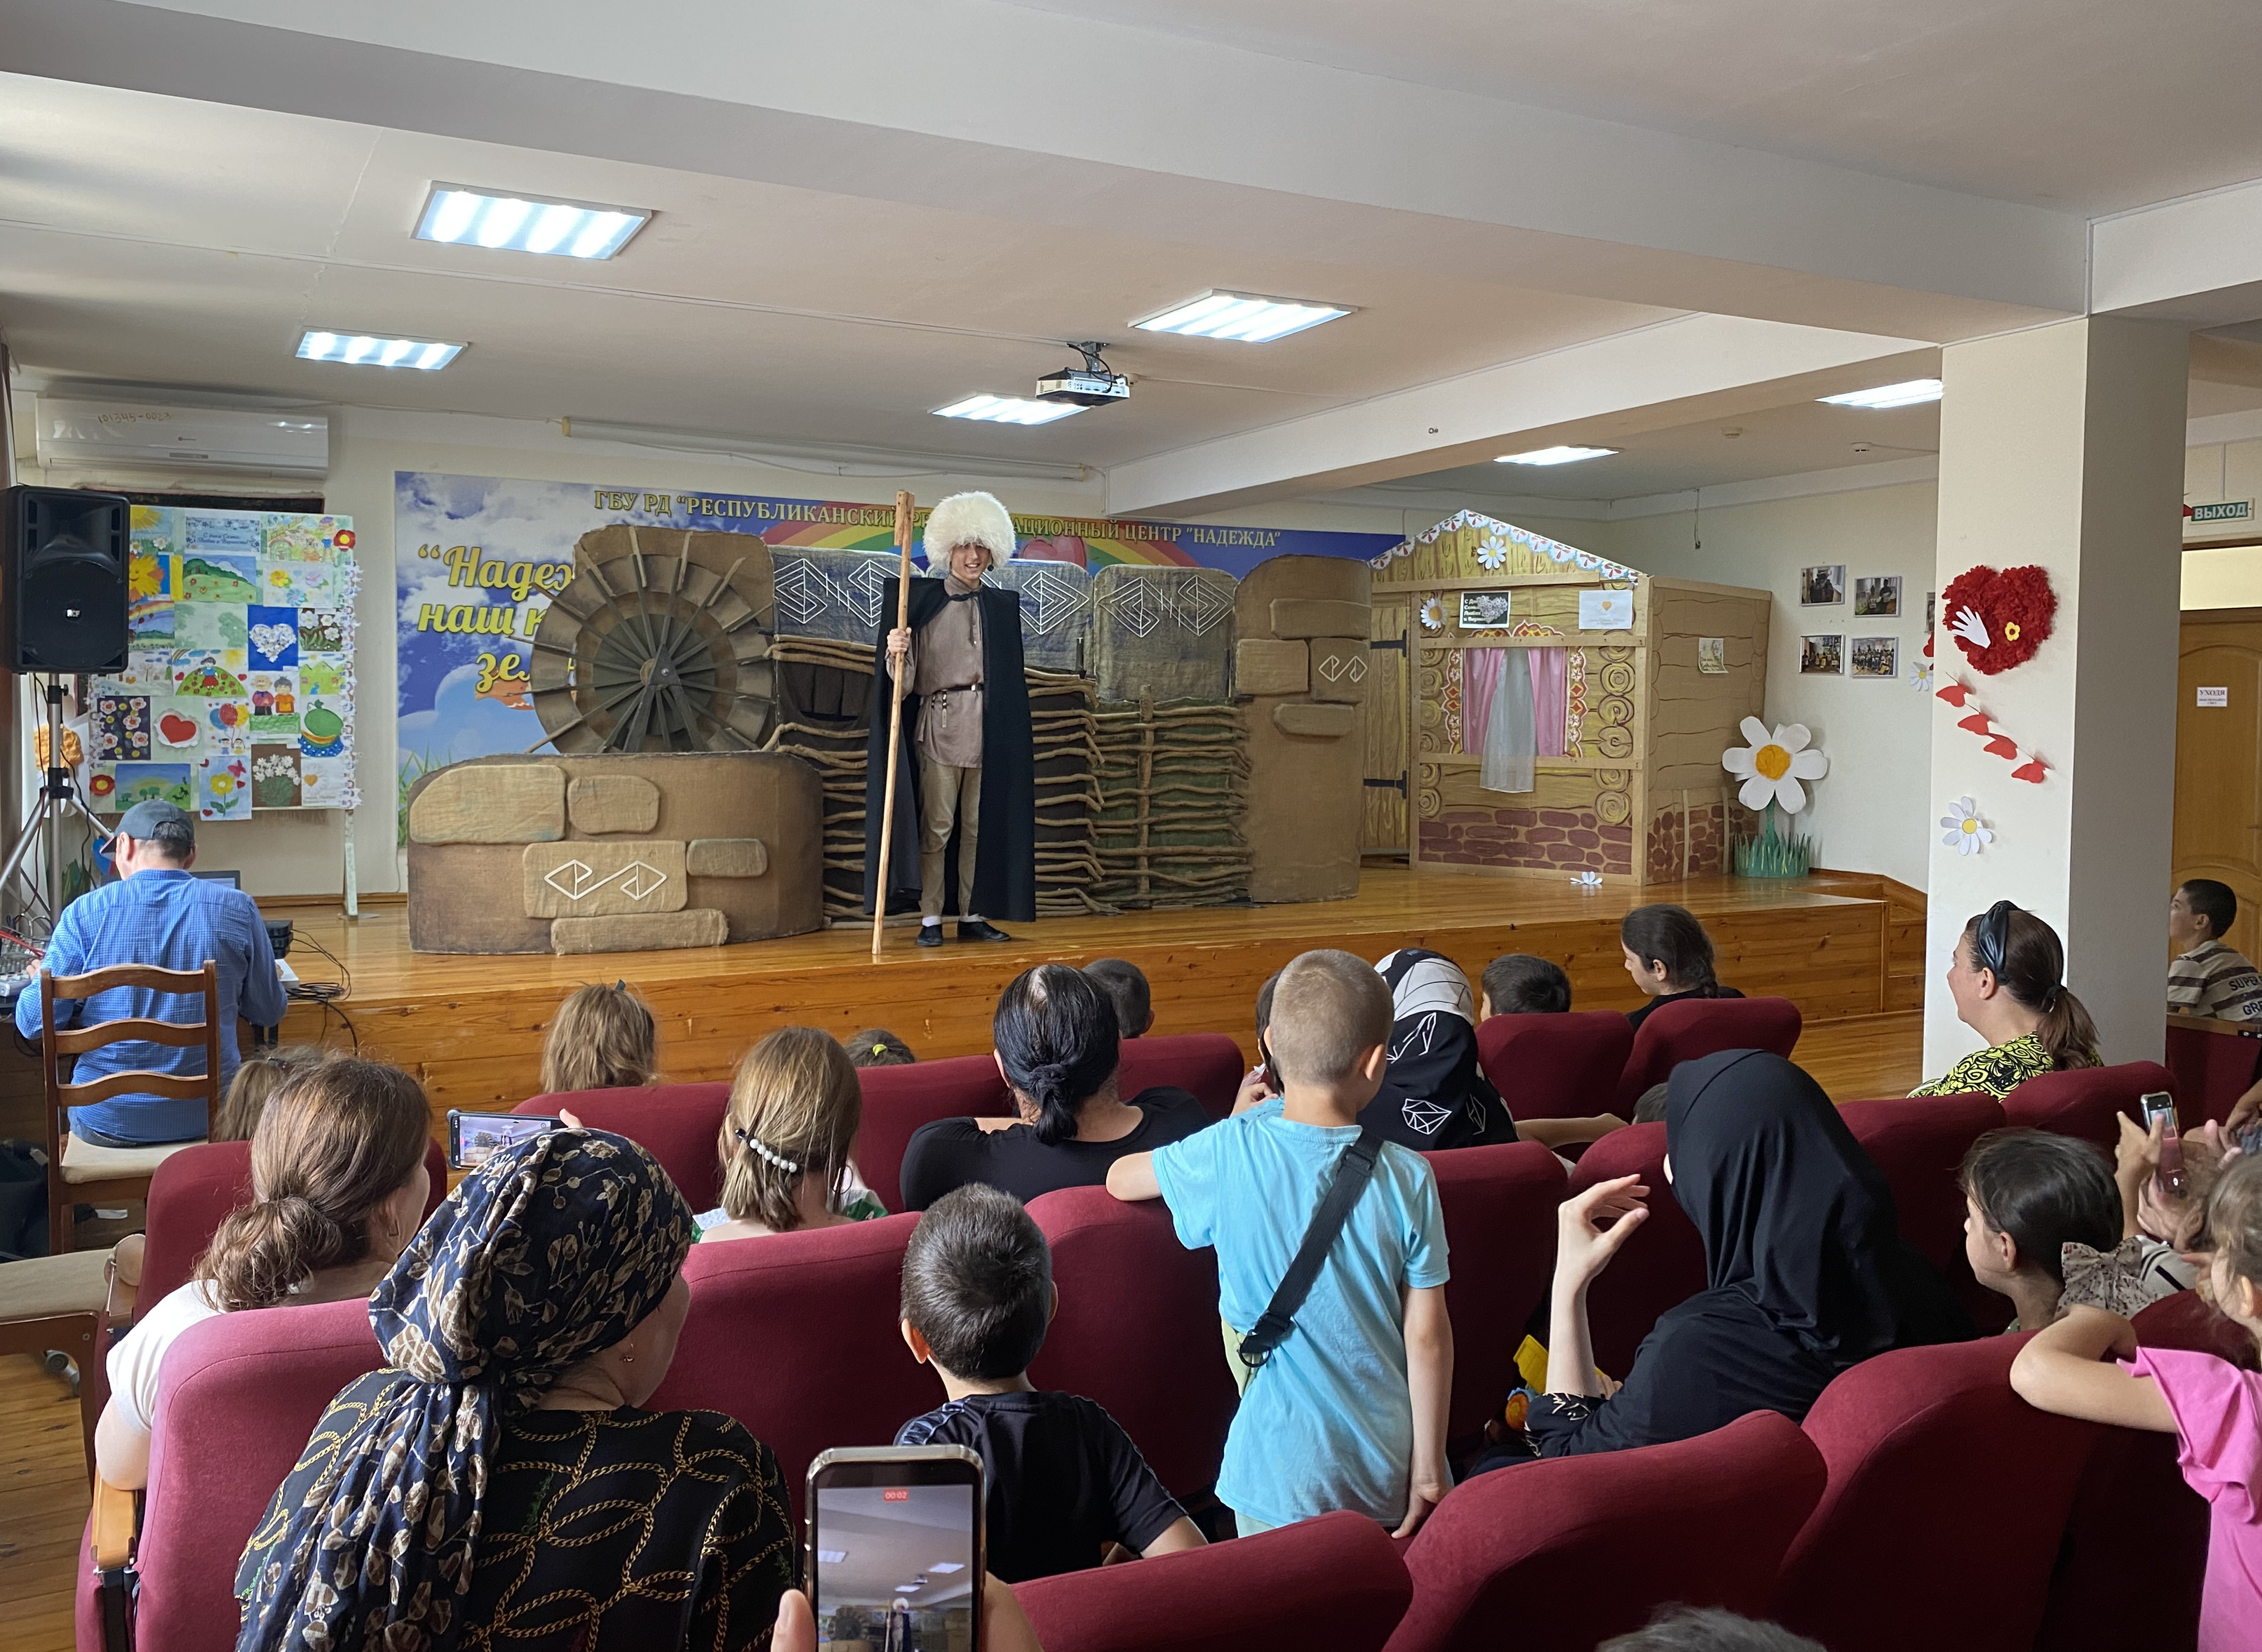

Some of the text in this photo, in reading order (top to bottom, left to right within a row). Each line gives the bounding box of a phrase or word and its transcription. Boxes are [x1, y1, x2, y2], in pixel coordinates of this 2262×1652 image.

[594, 491, 638, 510] ГБУ
[644, 494, 671, 517] РД
[677, 495, 897, 527] “РЕСПУБЛИКАНСКИЙ
[1125, 524, 1182, 544] ЦЕНТР
[2195, 504, 2247, 519] ВЫХОД
[417, 604, 515, 635] наш
[885, 1491, 907, 1500] 00:02
